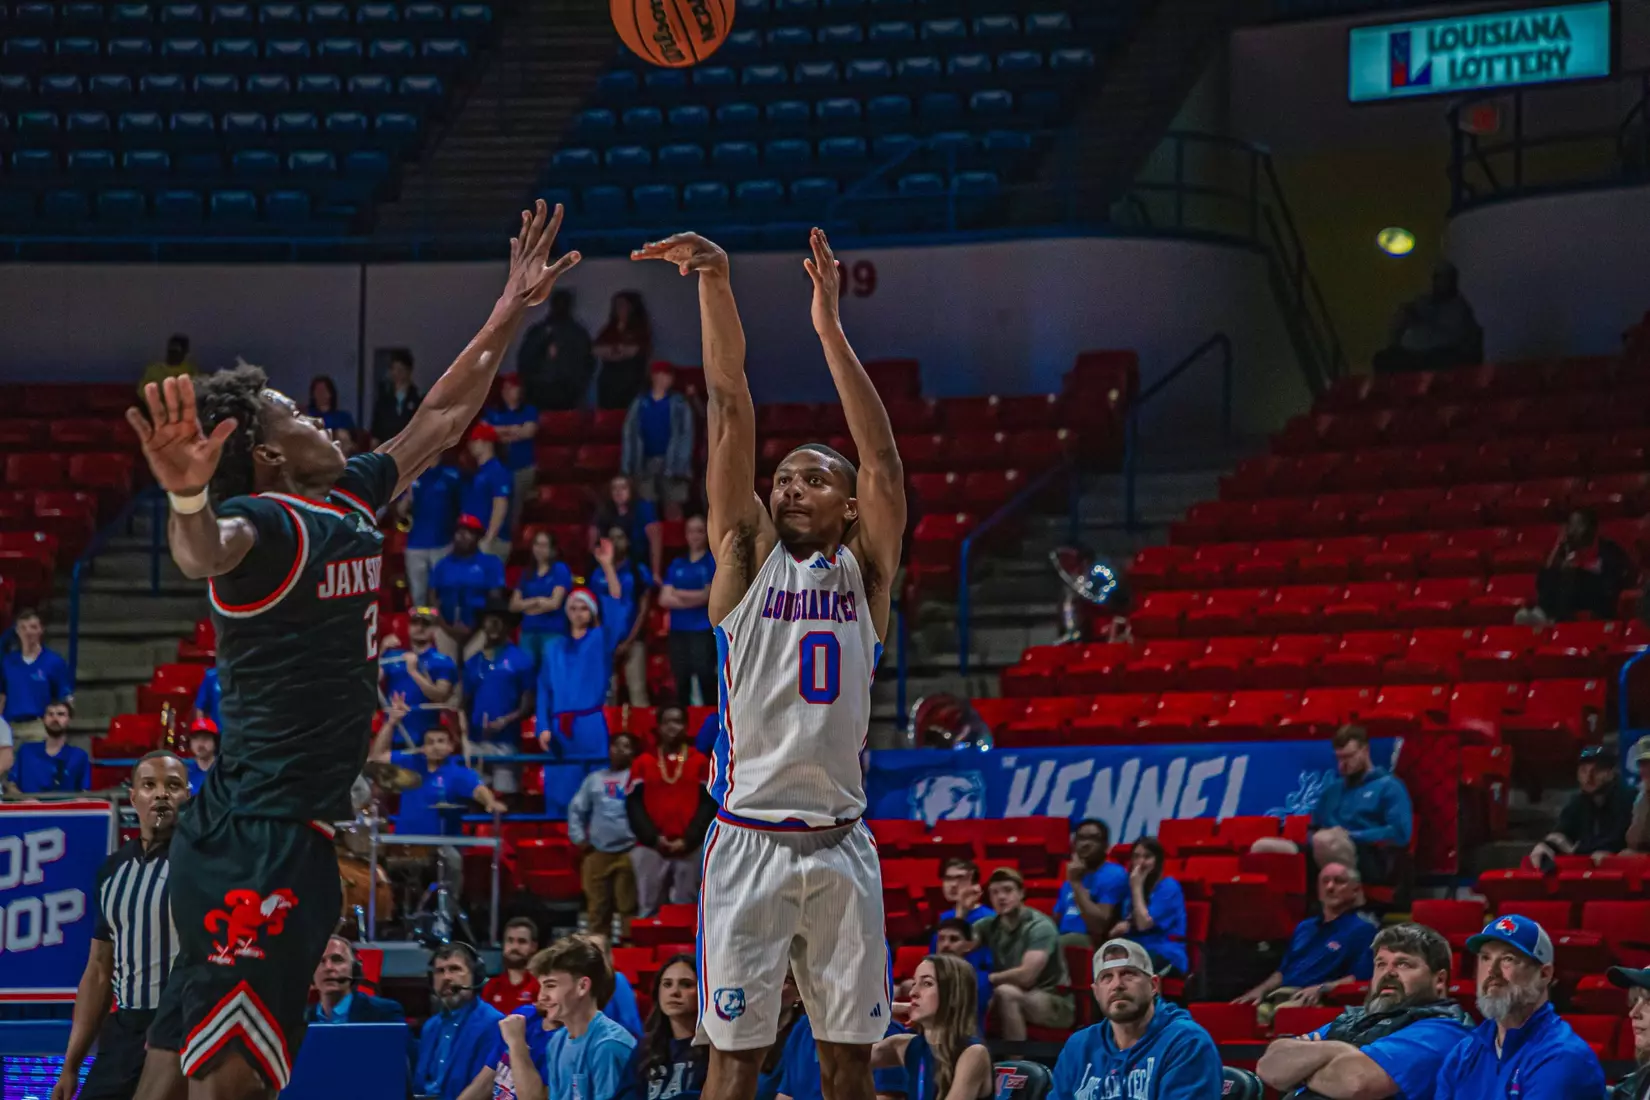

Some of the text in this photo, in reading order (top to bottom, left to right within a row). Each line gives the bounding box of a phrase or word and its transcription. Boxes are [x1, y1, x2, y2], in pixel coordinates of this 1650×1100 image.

[1428, 14, 1572, 53] LOUISIANA
[1450, 45, 1572, 82] LOTTERY
[798, 631, 841, 704] 0
